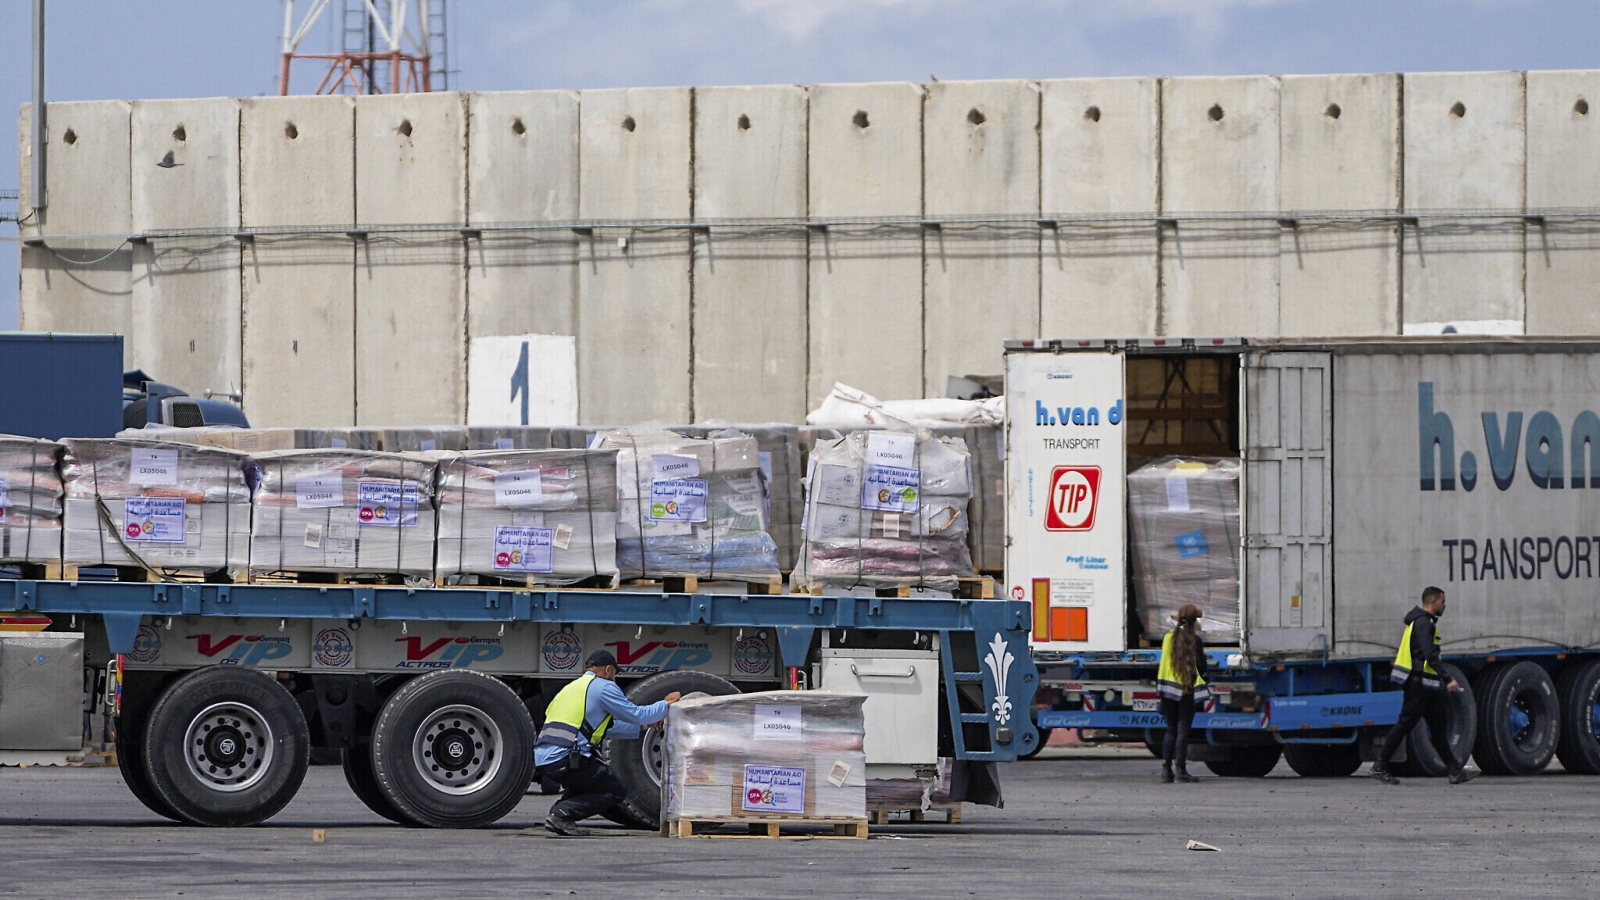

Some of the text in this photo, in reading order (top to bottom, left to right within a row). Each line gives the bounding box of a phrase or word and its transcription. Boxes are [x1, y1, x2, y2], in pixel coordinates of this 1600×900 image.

[510, 341, 528, 425] 1
[1036, 400, 1099, 426] h.van
[1043, 438, 1100, 449] TRANSPORT
[876, 452, 903, 460] LX05046
[662, 463, 689, 471] LX05046
[1058, 484, 1087, 513] TIP
[1013, 589, 1023, 598] 80
[259, 635, 290, 643] German
[470, 636, 501, 644] German
[679, 641, 708, 649] German
[1330, 706, 1363, 716] KRONE
[1131, 714, 1167, 725] KRON
[748, 769, 791, 777] HUMANITARIAN
